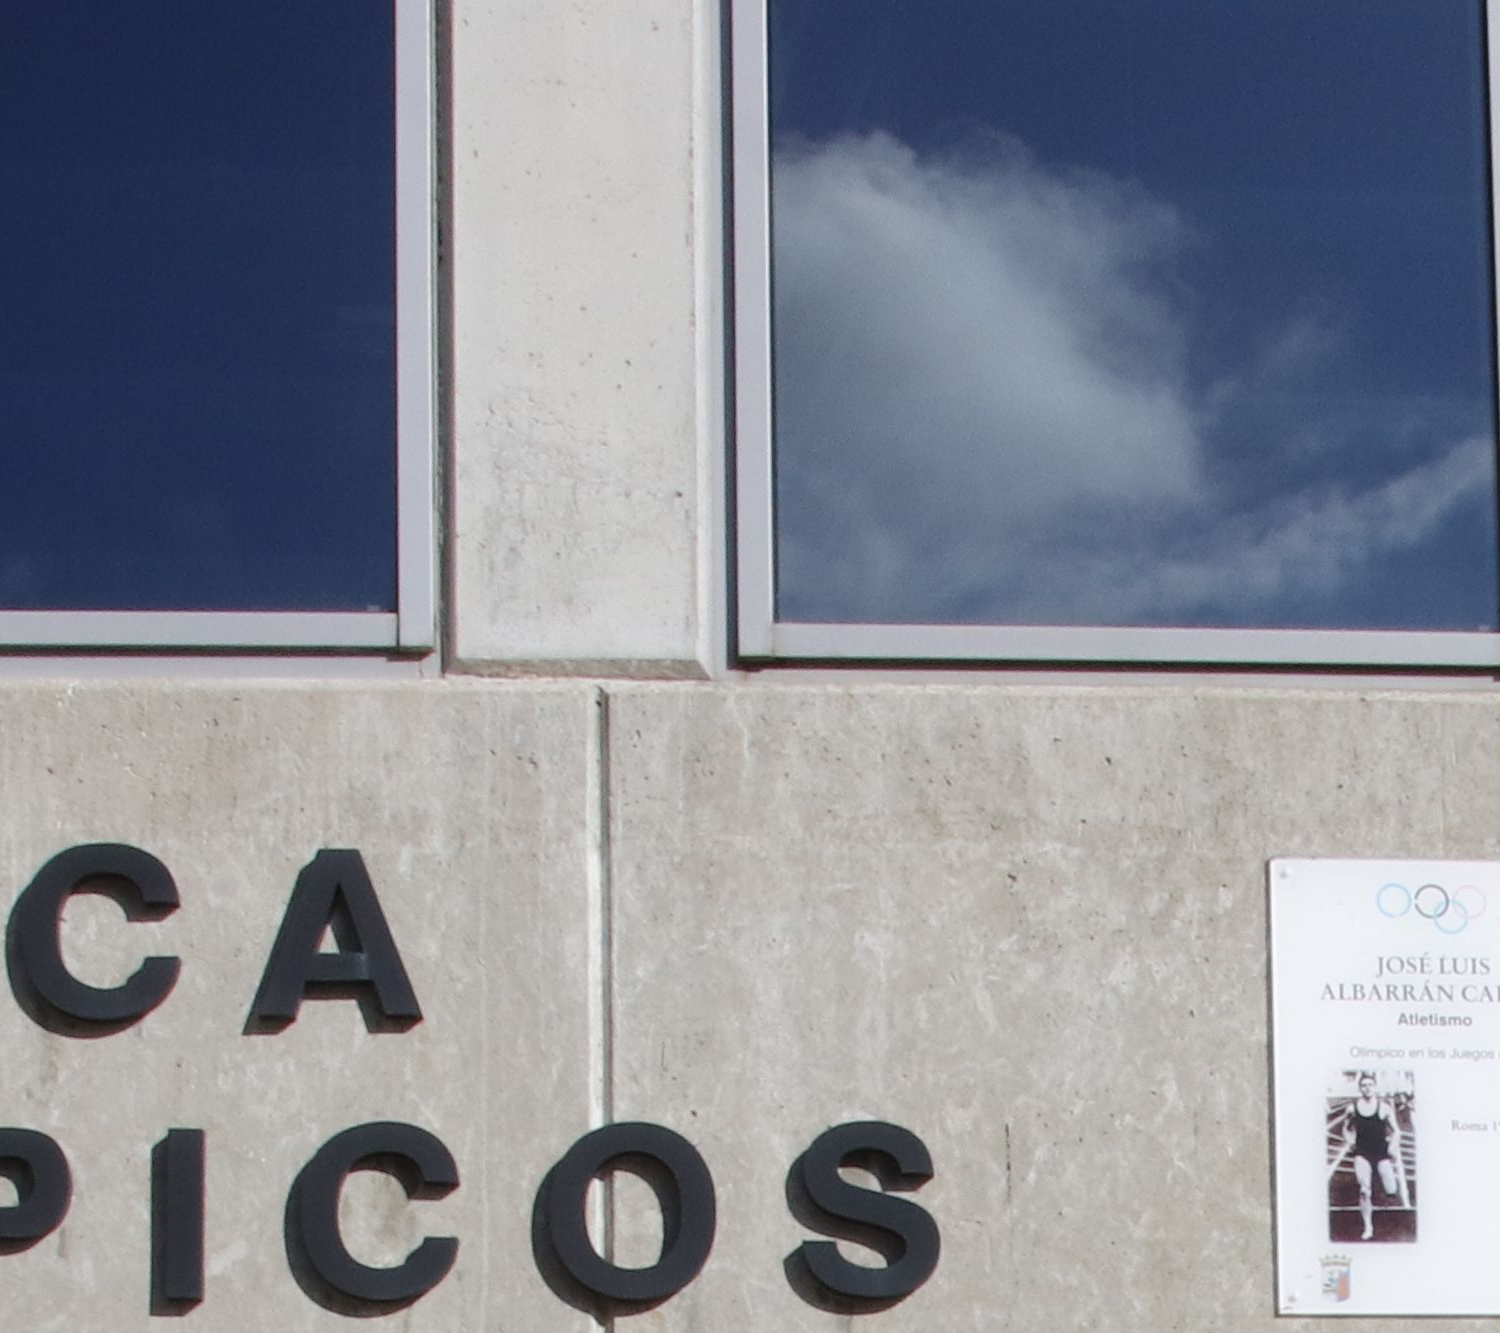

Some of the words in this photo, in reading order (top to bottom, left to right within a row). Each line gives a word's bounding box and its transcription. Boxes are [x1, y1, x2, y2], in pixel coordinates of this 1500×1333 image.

[1376, 952, 1432, 978] JOSÉ
[1440, 957, 1490, 975] LUIS
[1321, 980, 1453, 1002] ALBARRÁN
[1398, 1013, 1472, 1026] Atletismo
[1408, 1049, 1424, 1058] en
[1427, 1047, 1446, 1059] los
[1450, 1048, 1495, 1062] Juegos
